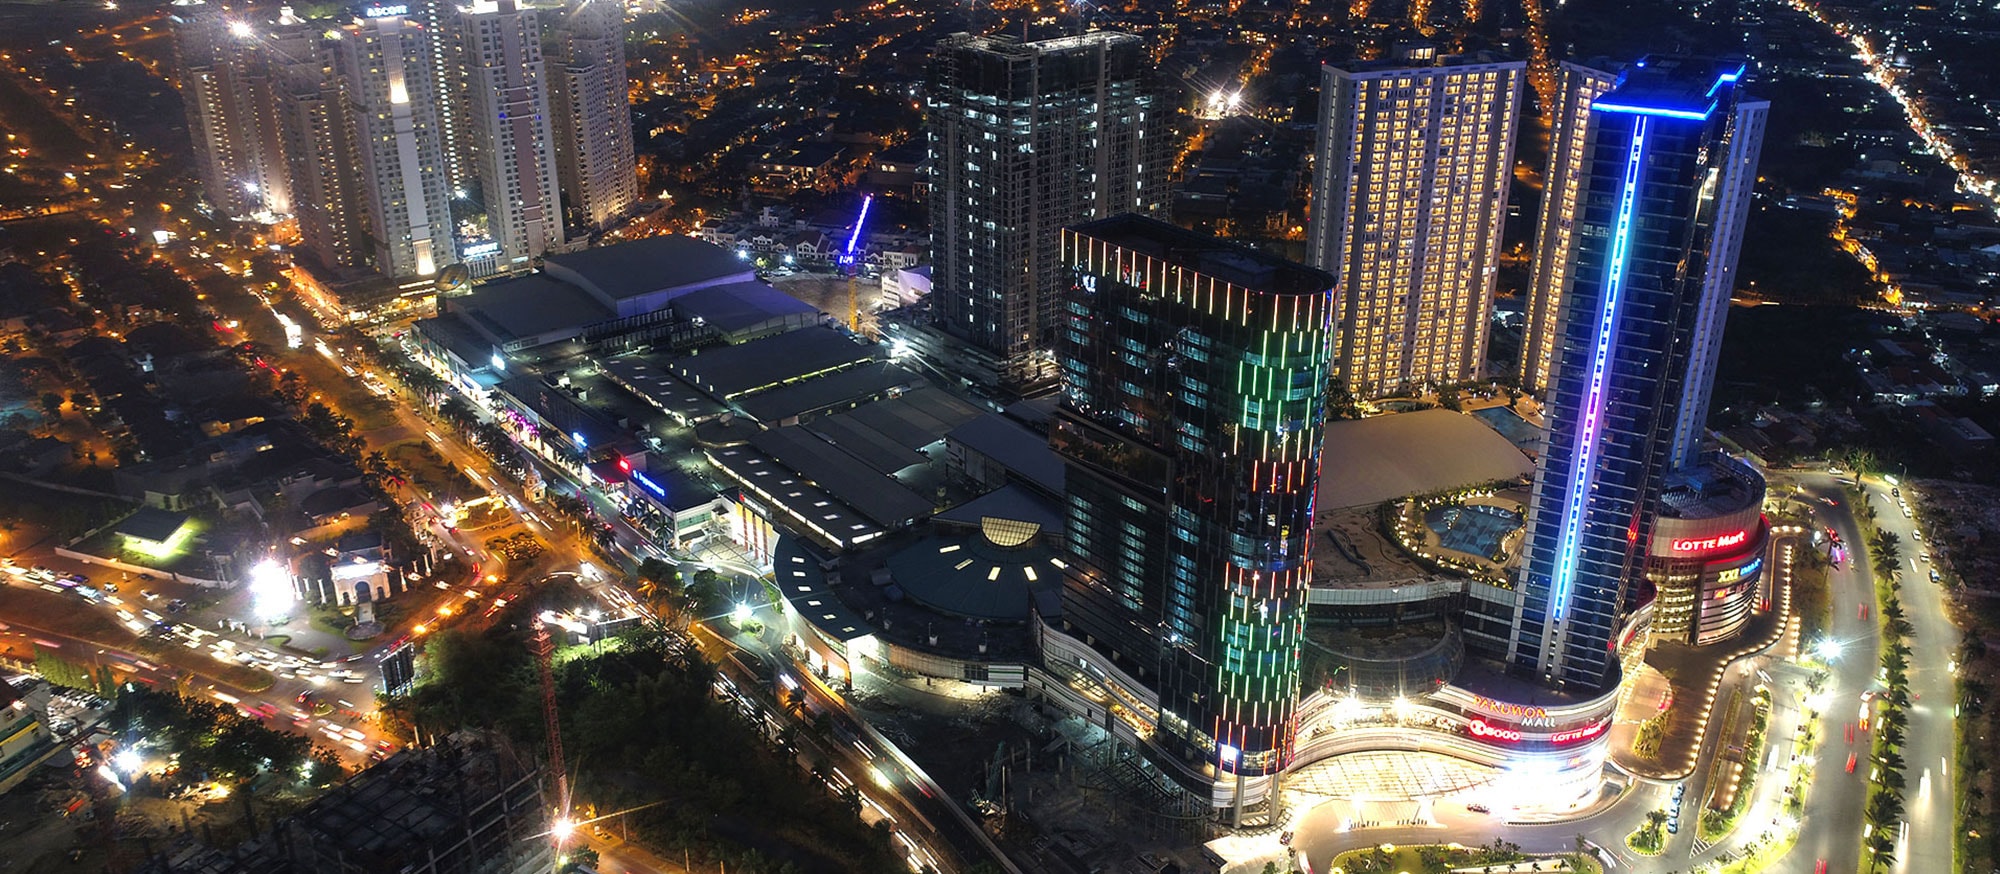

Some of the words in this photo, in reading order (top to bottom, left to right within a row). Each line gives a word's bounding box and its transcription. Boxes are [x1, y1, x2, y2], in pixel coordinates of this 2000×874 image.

[367, 5, 408, 17] ASCOTT
[1673, 539, 1717, 551] LOTTE
[1717, 531, 1745, 547] Mart
[1718, 568, 1740, 582] XXI
[1473, 694, 1547, 719] PAKUWON
[1521, 717, 1556, 728] MALL
[1552, 731, 1582, 742] LOTTE
